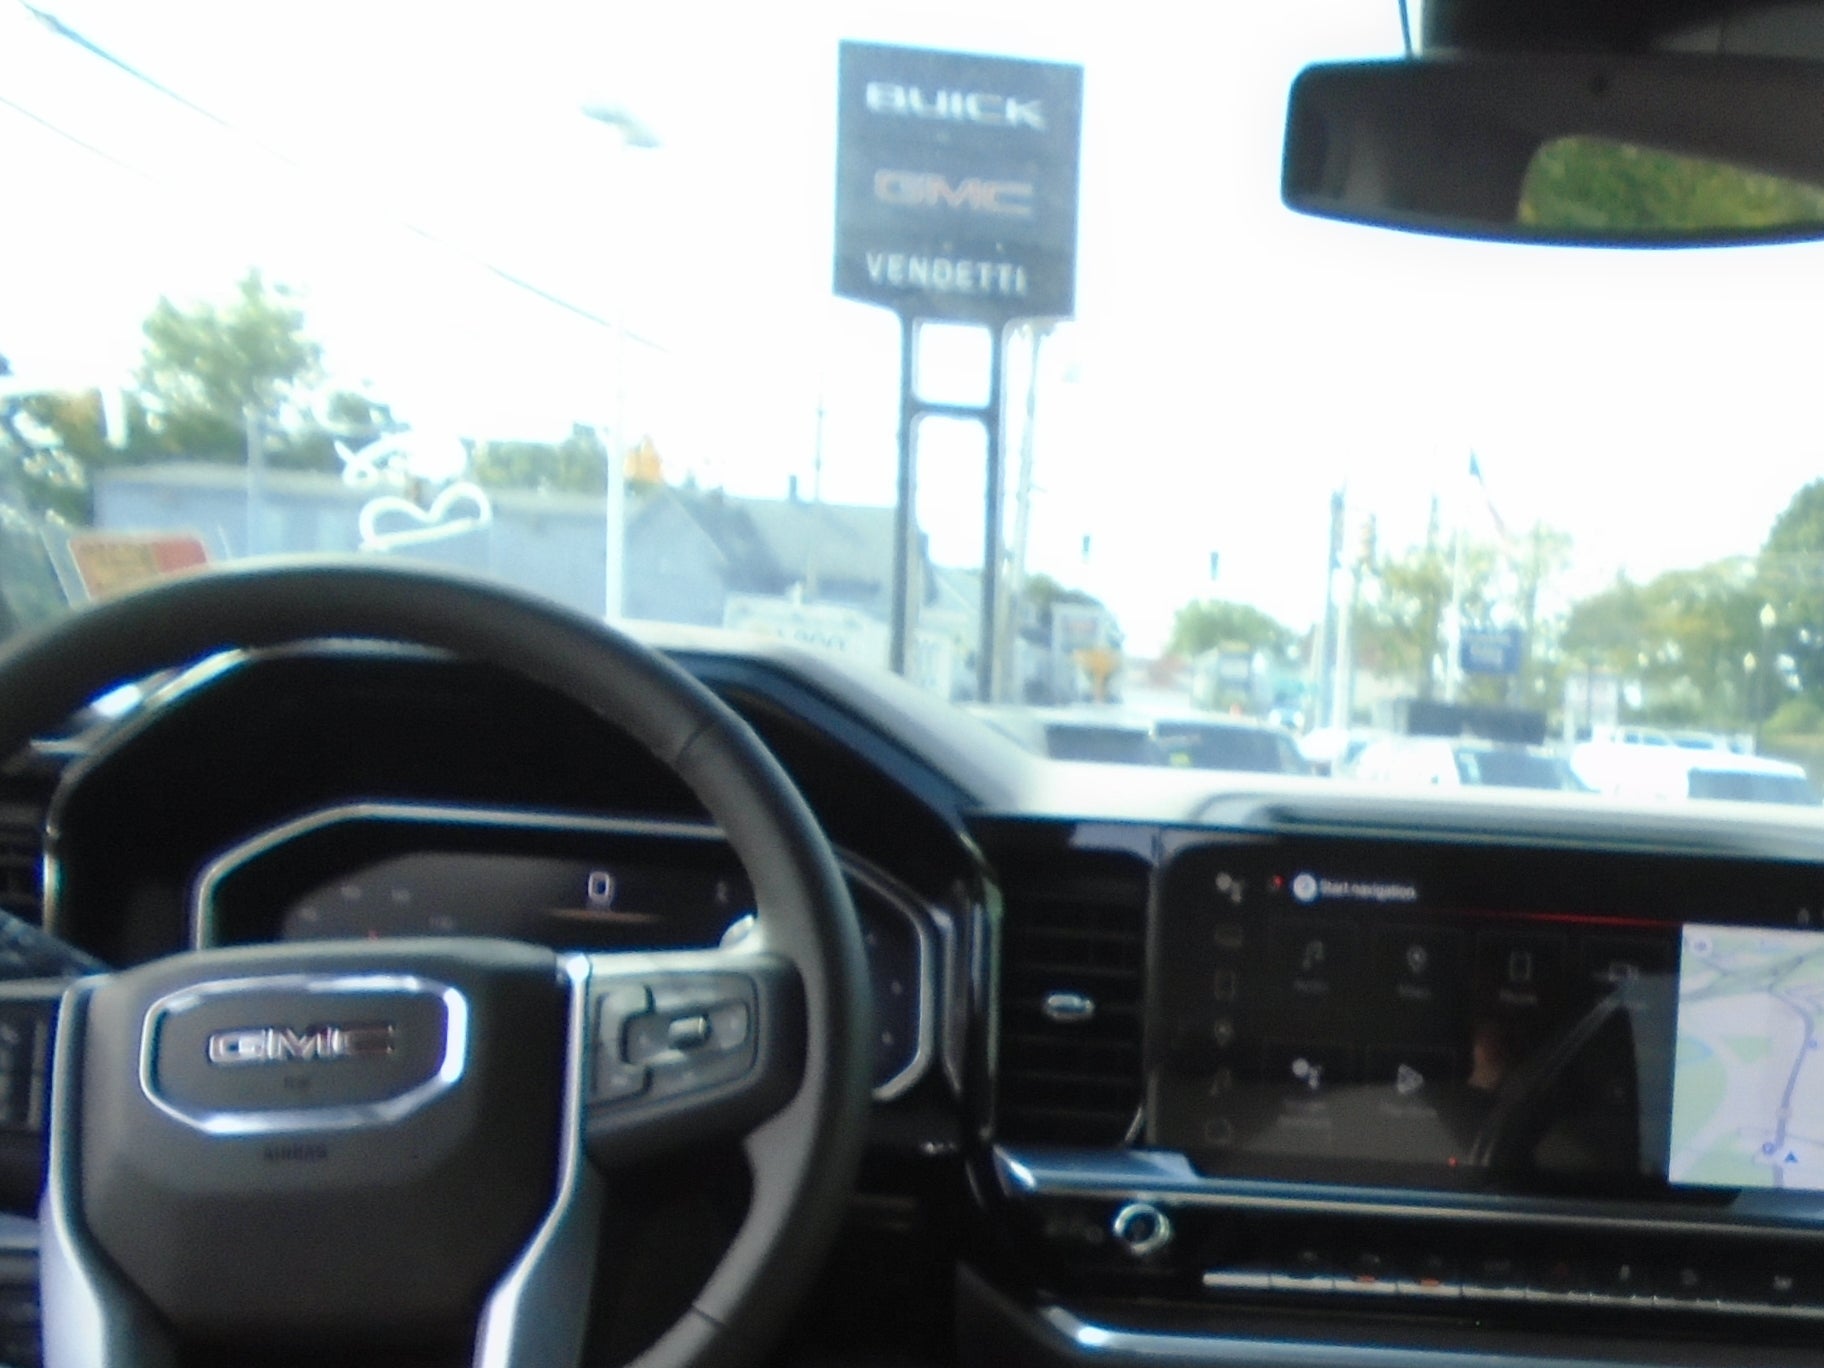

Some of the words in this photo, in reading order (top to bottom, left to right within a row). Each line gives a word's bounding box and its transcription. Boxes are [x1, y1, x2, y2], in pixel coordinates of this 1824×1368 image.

[866, 81, 1046, 131] BUICK
[874, 168, 1034, 219] GMC
[865, 251, 1028, 297] VENDETTI
[208, 1022, 396, 1064] GMC
